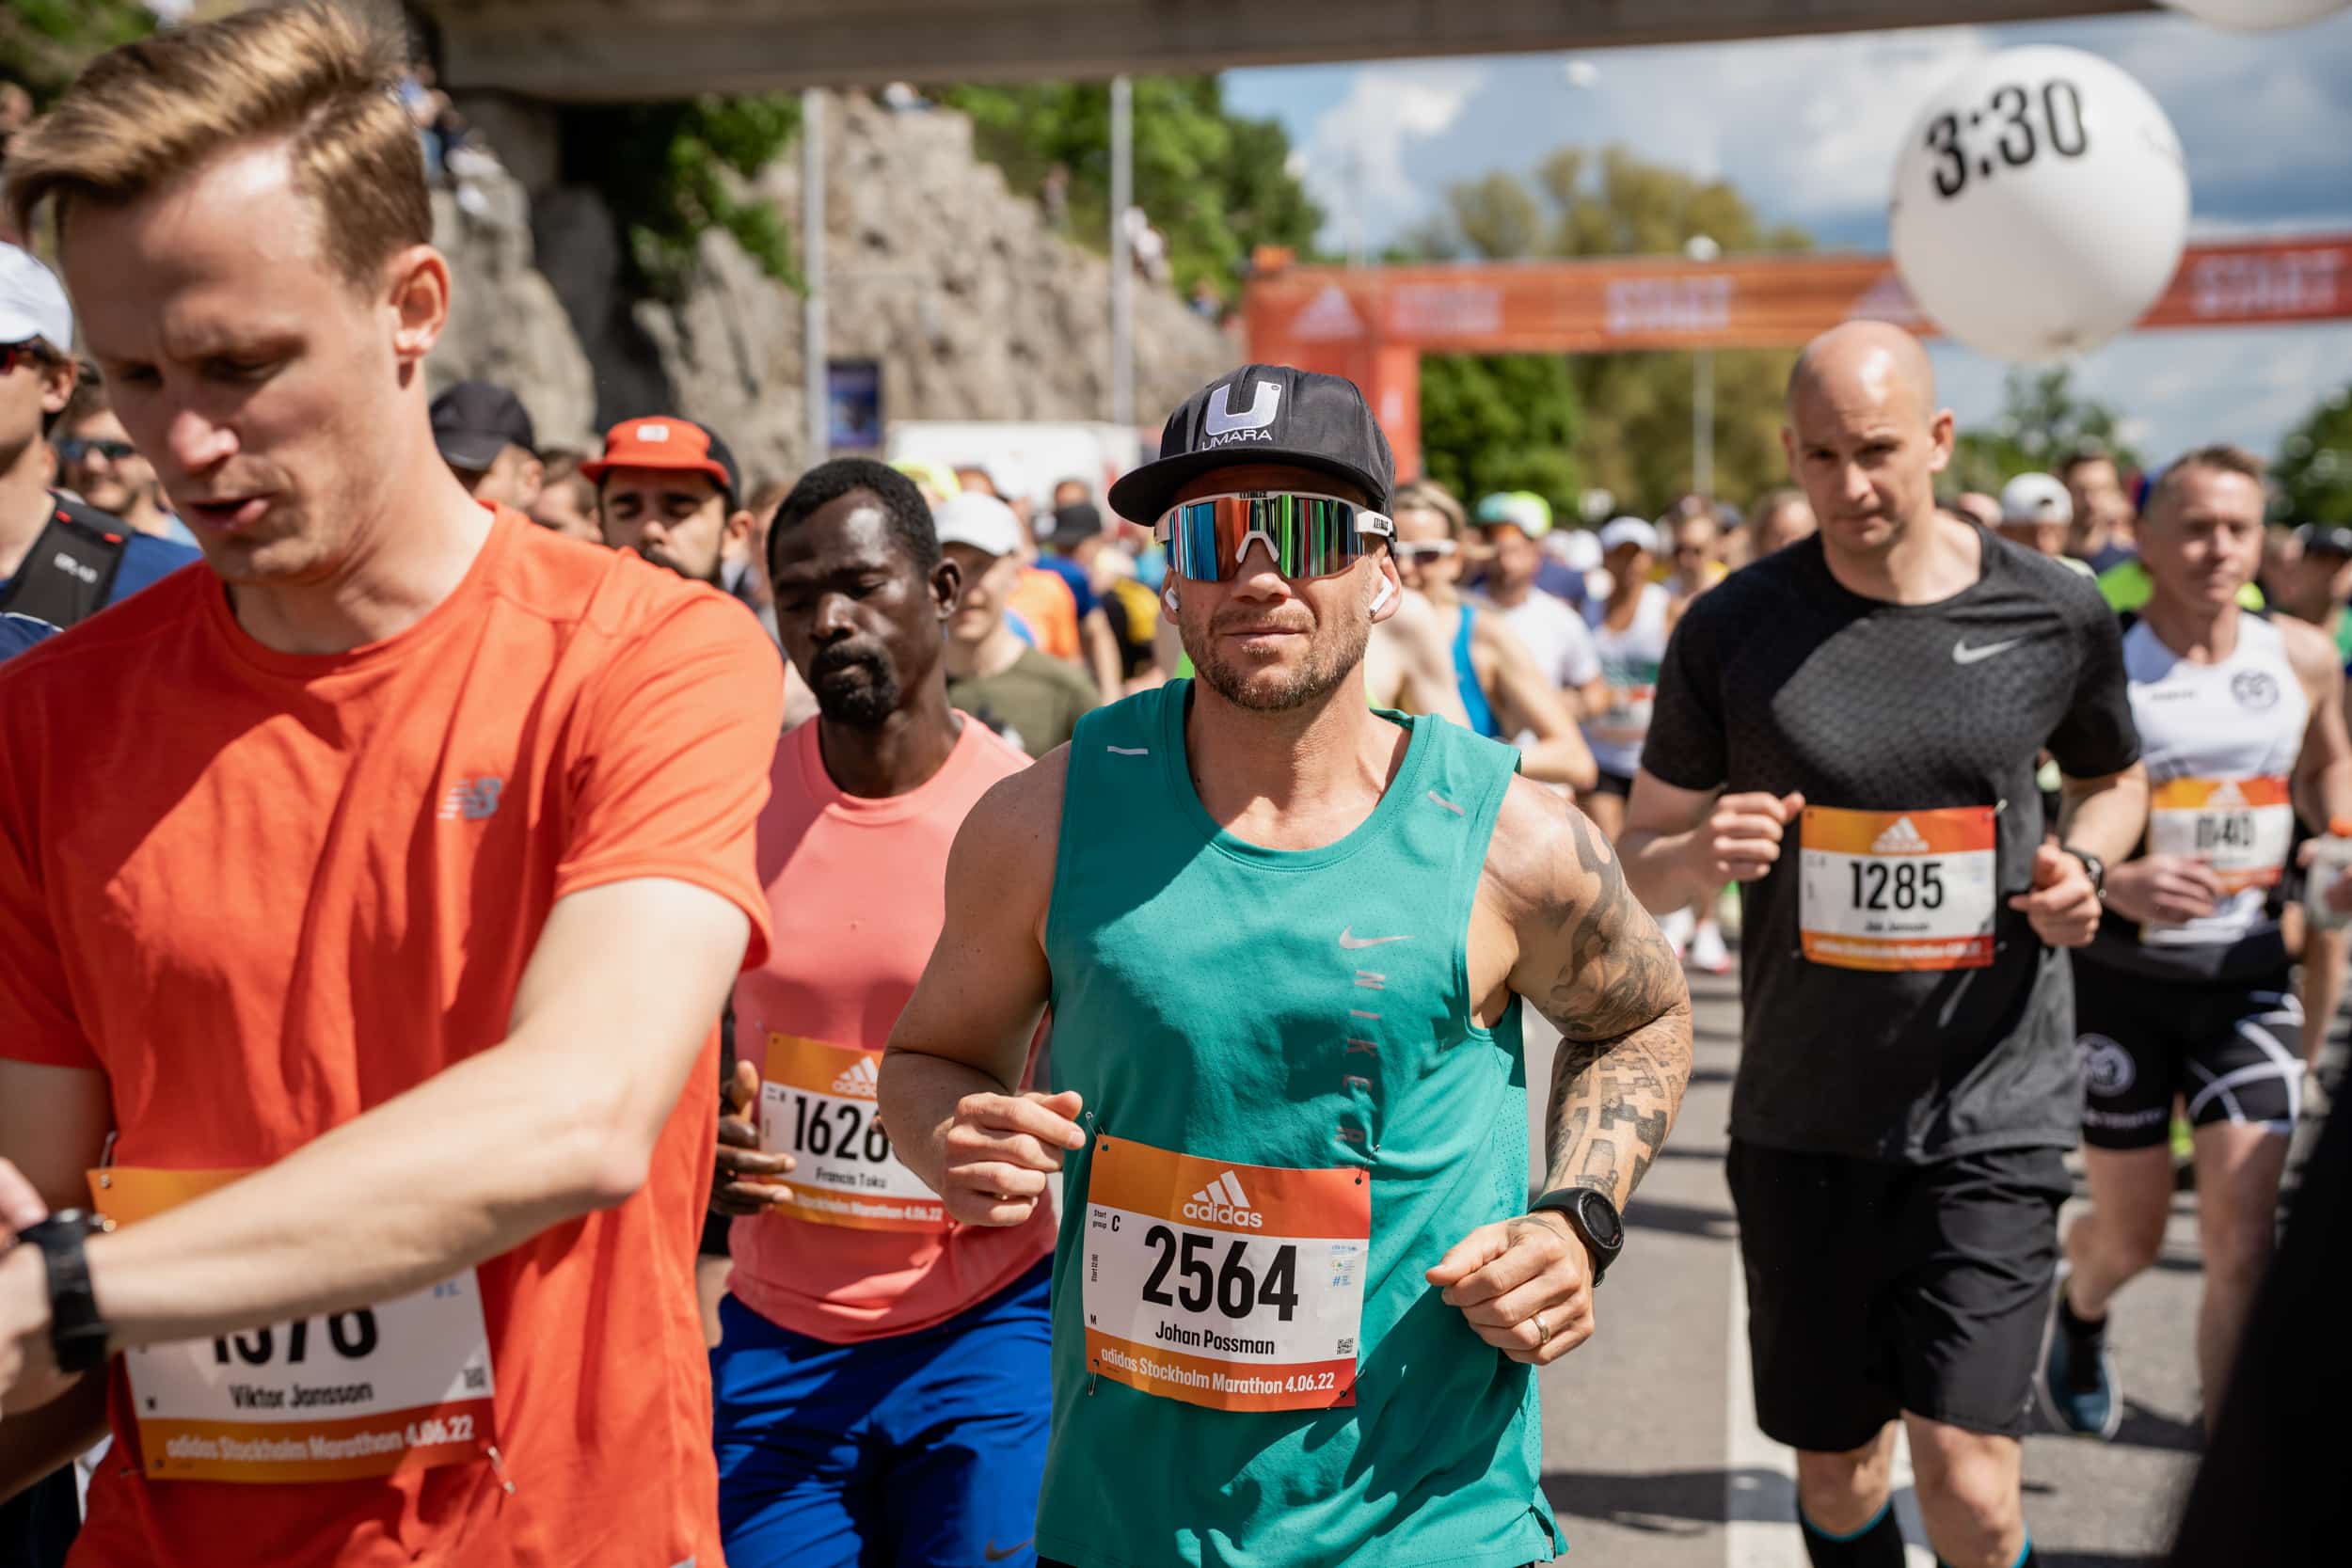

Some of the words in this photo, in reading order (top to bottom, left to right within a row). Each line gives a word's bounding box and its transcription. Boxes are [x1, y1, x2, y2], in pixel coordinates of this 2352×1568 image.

[1927, 79, 2088, 198] 3:30
[1201, 428, 1273, 451] UMARA
[1850, 860, 1944, 911] 1285
[794, 1096, 890, 1163] 1626
[816, 1166, 856, 1186] Francis
[1111, 1214, 1120, 1232] C
[1183, 1202, 1263, 1227] adidas
[1142, 1225, 1298, 1322] 2564
[1155, 1321, 1200, 1347] Johan
[1203, 1329, 1275, 1354] Possman
[1101, 1348, 1137, 1372] adidas
[1139, 1356, 1211, 1388] Stockholm
[1212, 1372, 1283, 1395] Marathon
[1285, 1371, 1335, 1393] 4.06.22
[229, 1384, 284, 1409] Viktor
